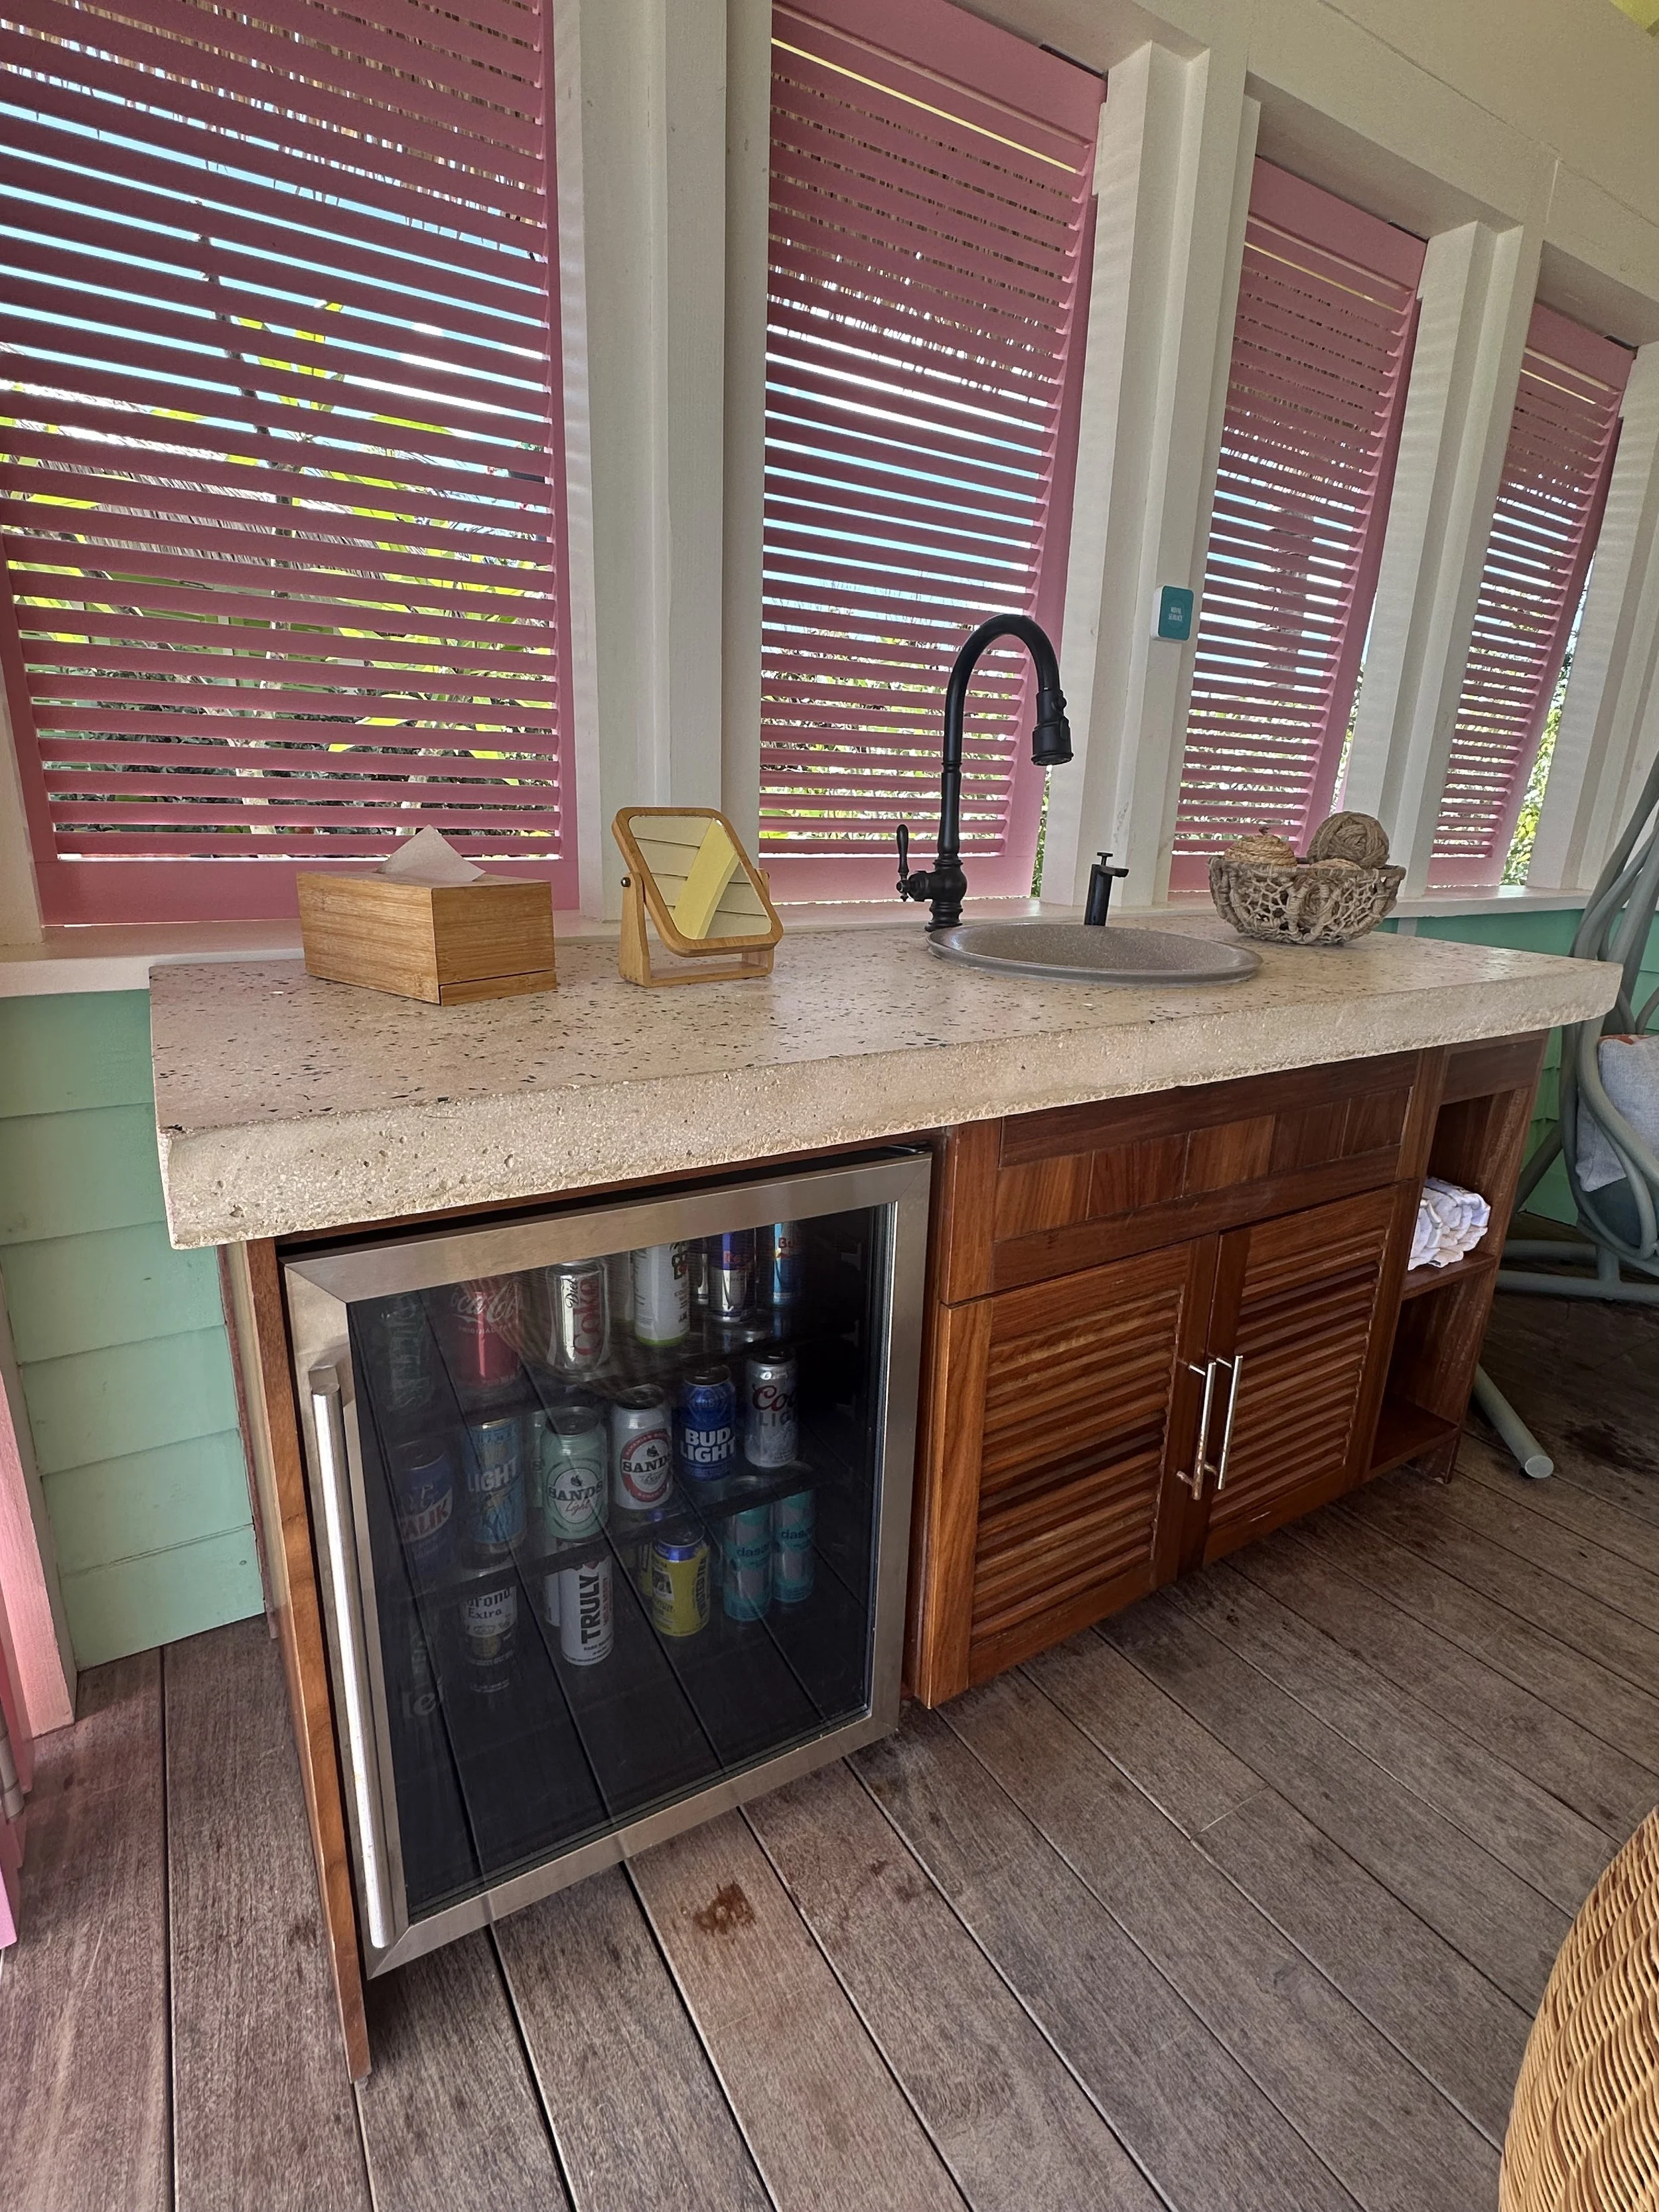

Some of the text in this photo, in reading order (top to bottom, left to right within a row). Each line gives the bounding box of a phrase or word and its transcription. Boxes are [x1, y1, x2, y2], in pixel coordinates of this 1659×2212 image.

[685, 1427, 731, 1447] BUD
[680, 1436, 736, 1463] LIGHT
[467, 1457, 518, 1493] LIGHT
[548, 1480, 603, 1501] SANDS
[468, 1607, 502, 1620] Extra
[579, 1574, 601, 1645] TRULY
